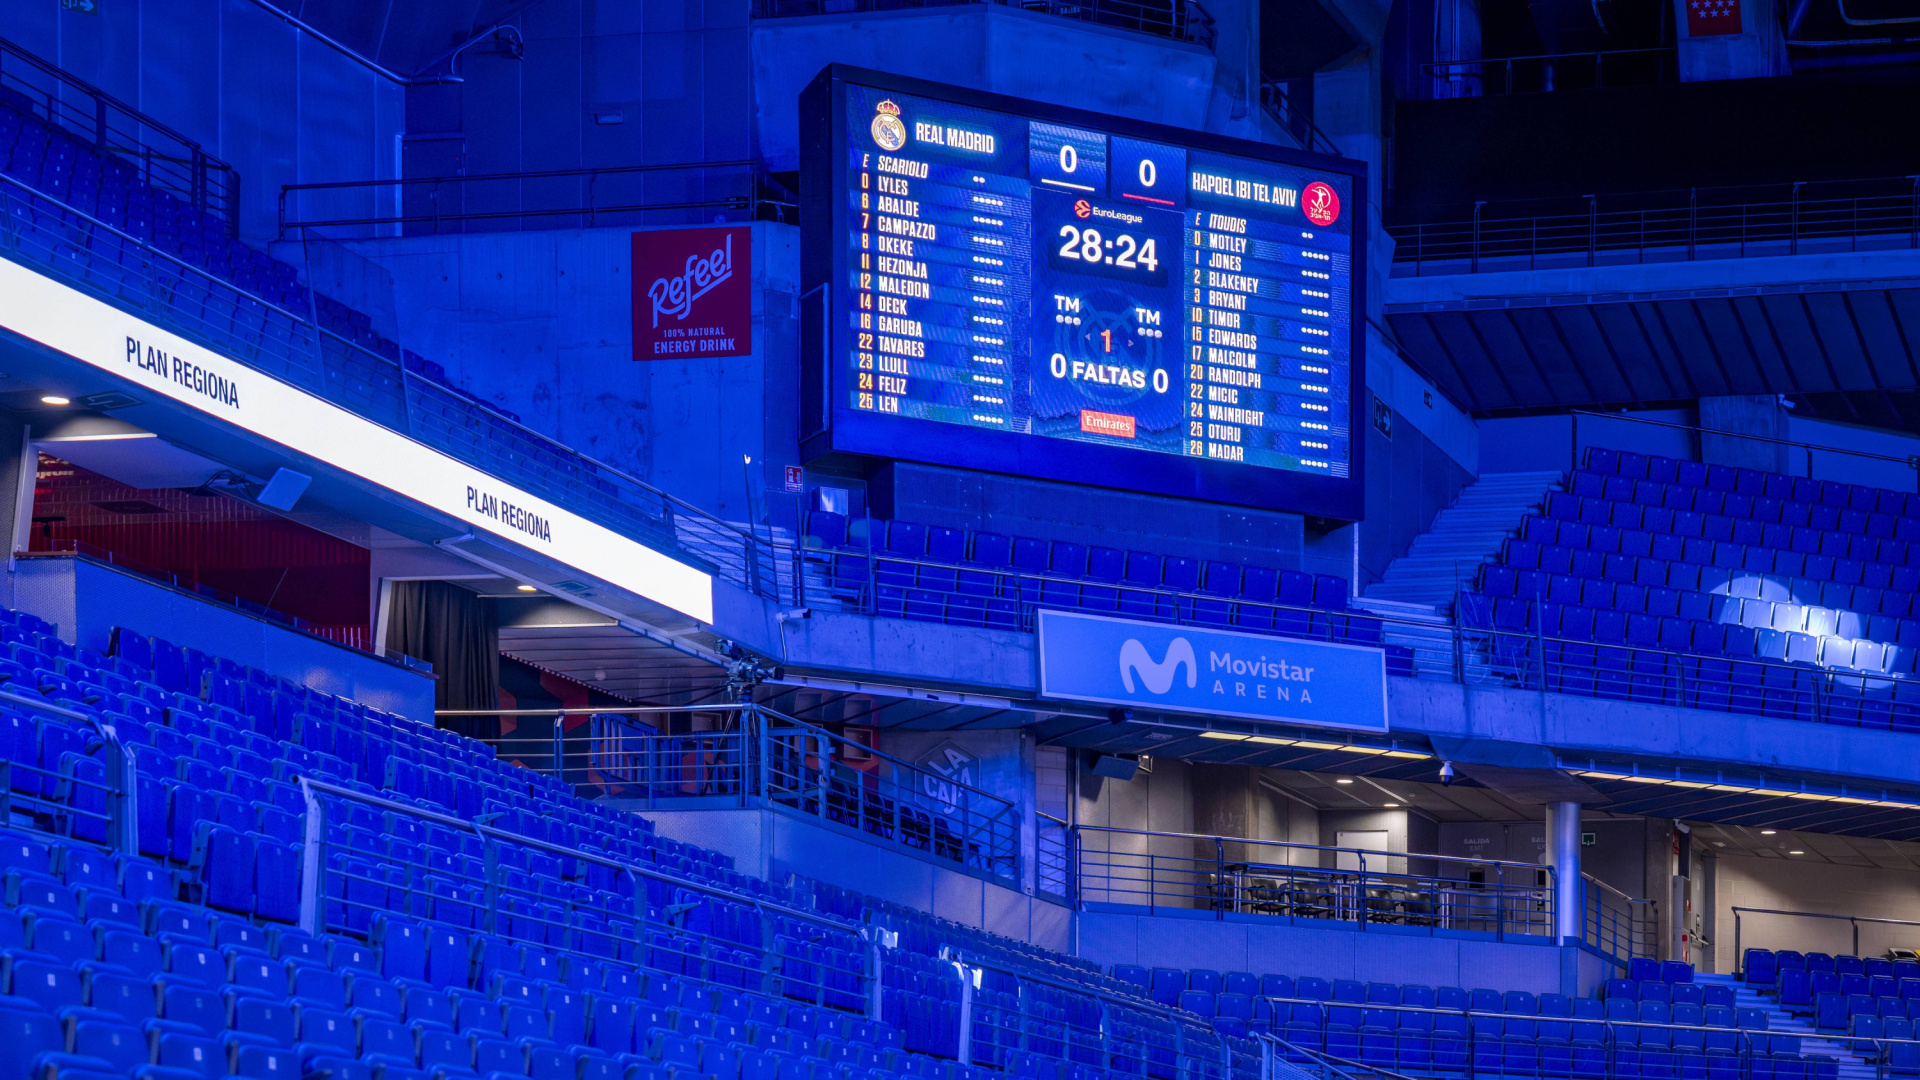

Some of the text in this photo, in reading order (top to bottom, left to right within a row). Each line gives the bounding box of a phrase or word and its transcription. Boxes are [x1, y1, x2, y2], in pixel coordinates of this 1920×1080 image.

[916, 122, 994, 153] REAL MADRID
[863, 153, 928, 179] E SCARIOLO
[1059, 145, 1077, 173] 0
[861, 173, 908, 196] 0 LYLES
[1139, 159, 1156, 187] 0
[1192, 172, 1297, 207] HAPOEL IBI TEL AVIV
[861, 193, 919, 218] 6 ABALDE
[1092, 207, 1143, 224] EuroLeague
[861, 213, 936, 240] 7 CAMPAZZO
[1195, 212, 1247, 234] E ITOUDIS
[862, 233, 914, 256] 8 OKEKE
[1059, 225, 1158, 271] 28:24
[1194, 231, 1247, 254] 0 MOTLEY
[861, 253, 928, 279] 11 HEZONJA
[1208, 252, 1242, 272] JONES
[648, 233, 733, 329] Refeel
[860, 273, 930, 299] 12 MALEDON
[1194, 269, 1259, 293] 2 BLAKENEY
[860, 293, 907, 316] 14 DECK
[1054, 295, 1080, 312] TM
[1194, 288, 1247, 311] 3 BRYANT
[860, 313, 923, 338] 16 GARUBA
[1135, 308, 1160, 325] TM
[1192, 307, 1240, 329] 10 TIMOR
[663, 327, 725, 338] 100% NATURAL
[1100, 329, 1111, 352] 1
[1192, 326, 1257, 350] 15 EDWARDS
[654, 338, 735, 354] ENERGY DRINK
[859, 333, 924, 358] 22 TAVARES
[1192, 345, 1256, 369] 17 MALCOLM
[126, 336, 239, 409] PLAN REGIONA
[859, 353, 909, 375] 23 LLULL
[1050, 353, 1169, 393] 0 FALTAS 0
[859, 373, 907, 394] 24 FELIZ
[1190, 364, 1261, 389] 20 RANDOLPH
[859, 393, 898, 413] 25 LEN
[1190, 383, 1238, 404] 22 MICIC
[1086, 415, 1130, 432] Emirates
[1190, 402, 1264, 427] 24 WAINRIGHT
[1190, 421, 1241, 442] 25 OTURU
[1190, 440, 1243, 462] 26 MADAR
[467, 485, 551, 543] PLAN REGIONA
[1210, 651, 1314, 683] Movistar
[1213, 680, 1312, 704] ARENA
[928, 748, 970, 777] LA
